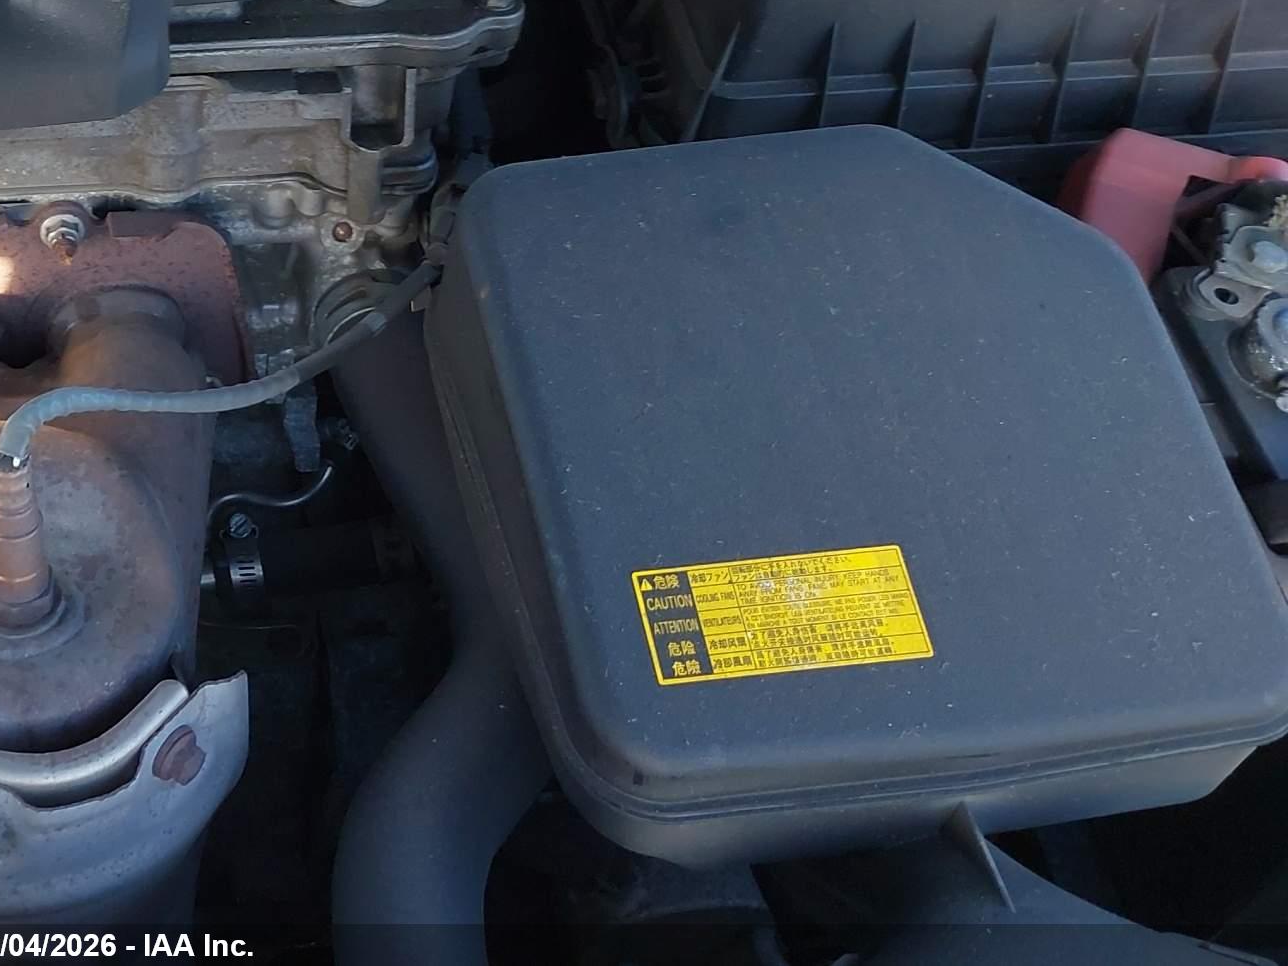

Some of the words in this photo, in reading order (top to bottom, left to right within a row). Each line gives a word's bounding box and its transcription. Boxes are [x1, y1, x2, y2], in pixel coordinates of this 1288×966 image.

[646, 594, 692, 610] CAUTION
[696, 593, 718, 602] COOLING
[653, 619, 698, 634] ATTENTION
